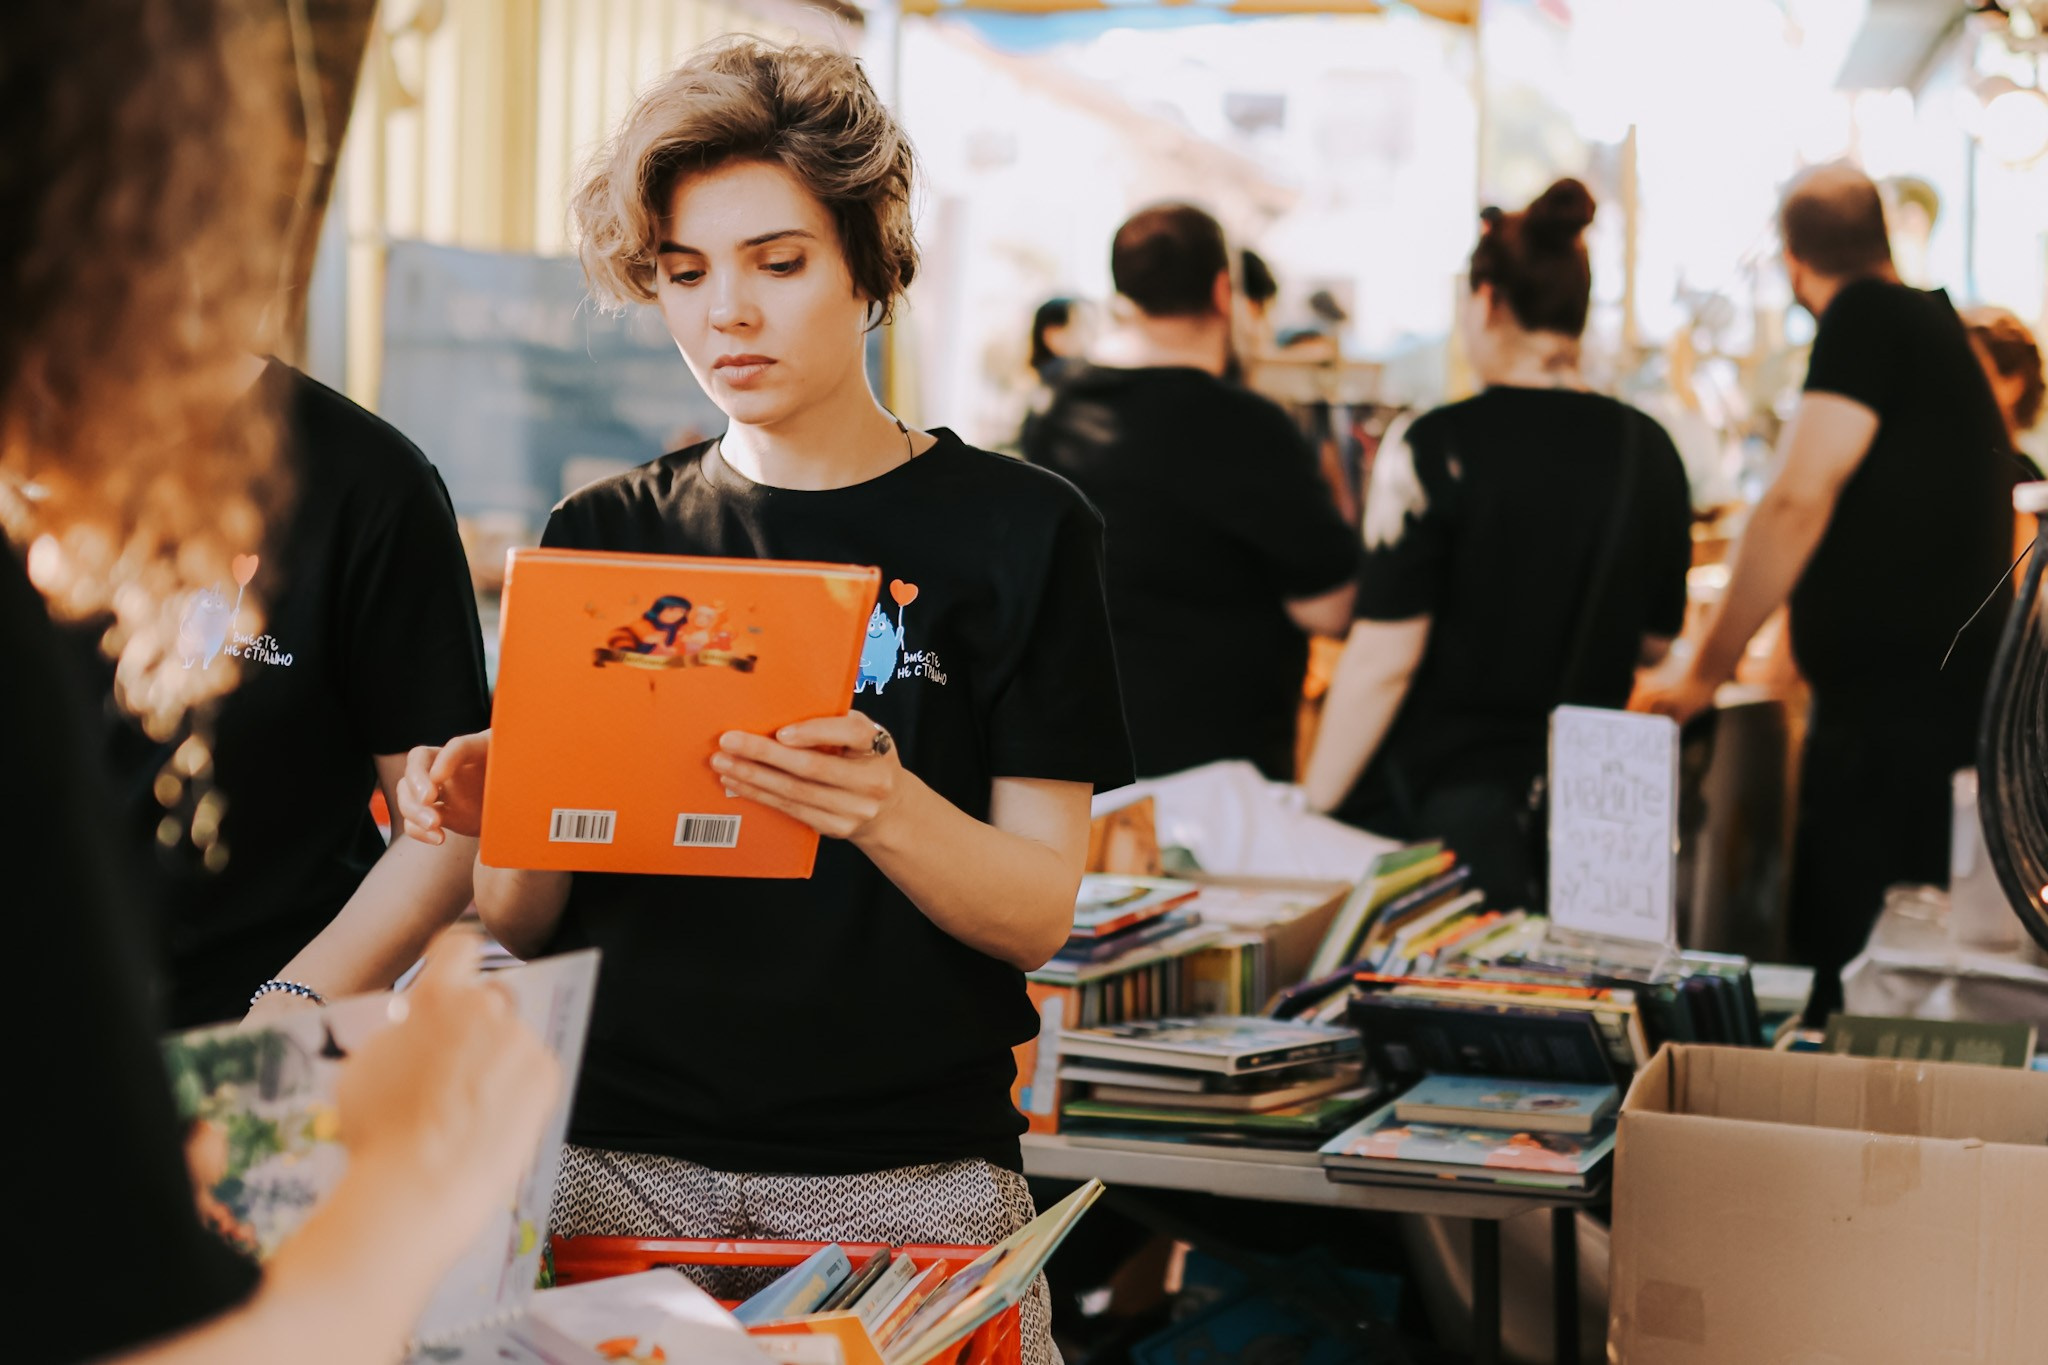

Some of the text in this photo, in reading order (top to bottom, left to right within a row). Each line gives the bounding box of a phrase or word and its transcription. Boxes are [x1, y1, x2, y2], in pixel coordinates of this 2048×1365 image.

[233, 632, 279, 651] ВМЕСТЕ
[224, 645, 293, 666] НЕ СТРАШНО
[904, 650, 940, 667] ВМЕСТЕ
[897, 663, 947, 685] НЕ СТРАШНО
